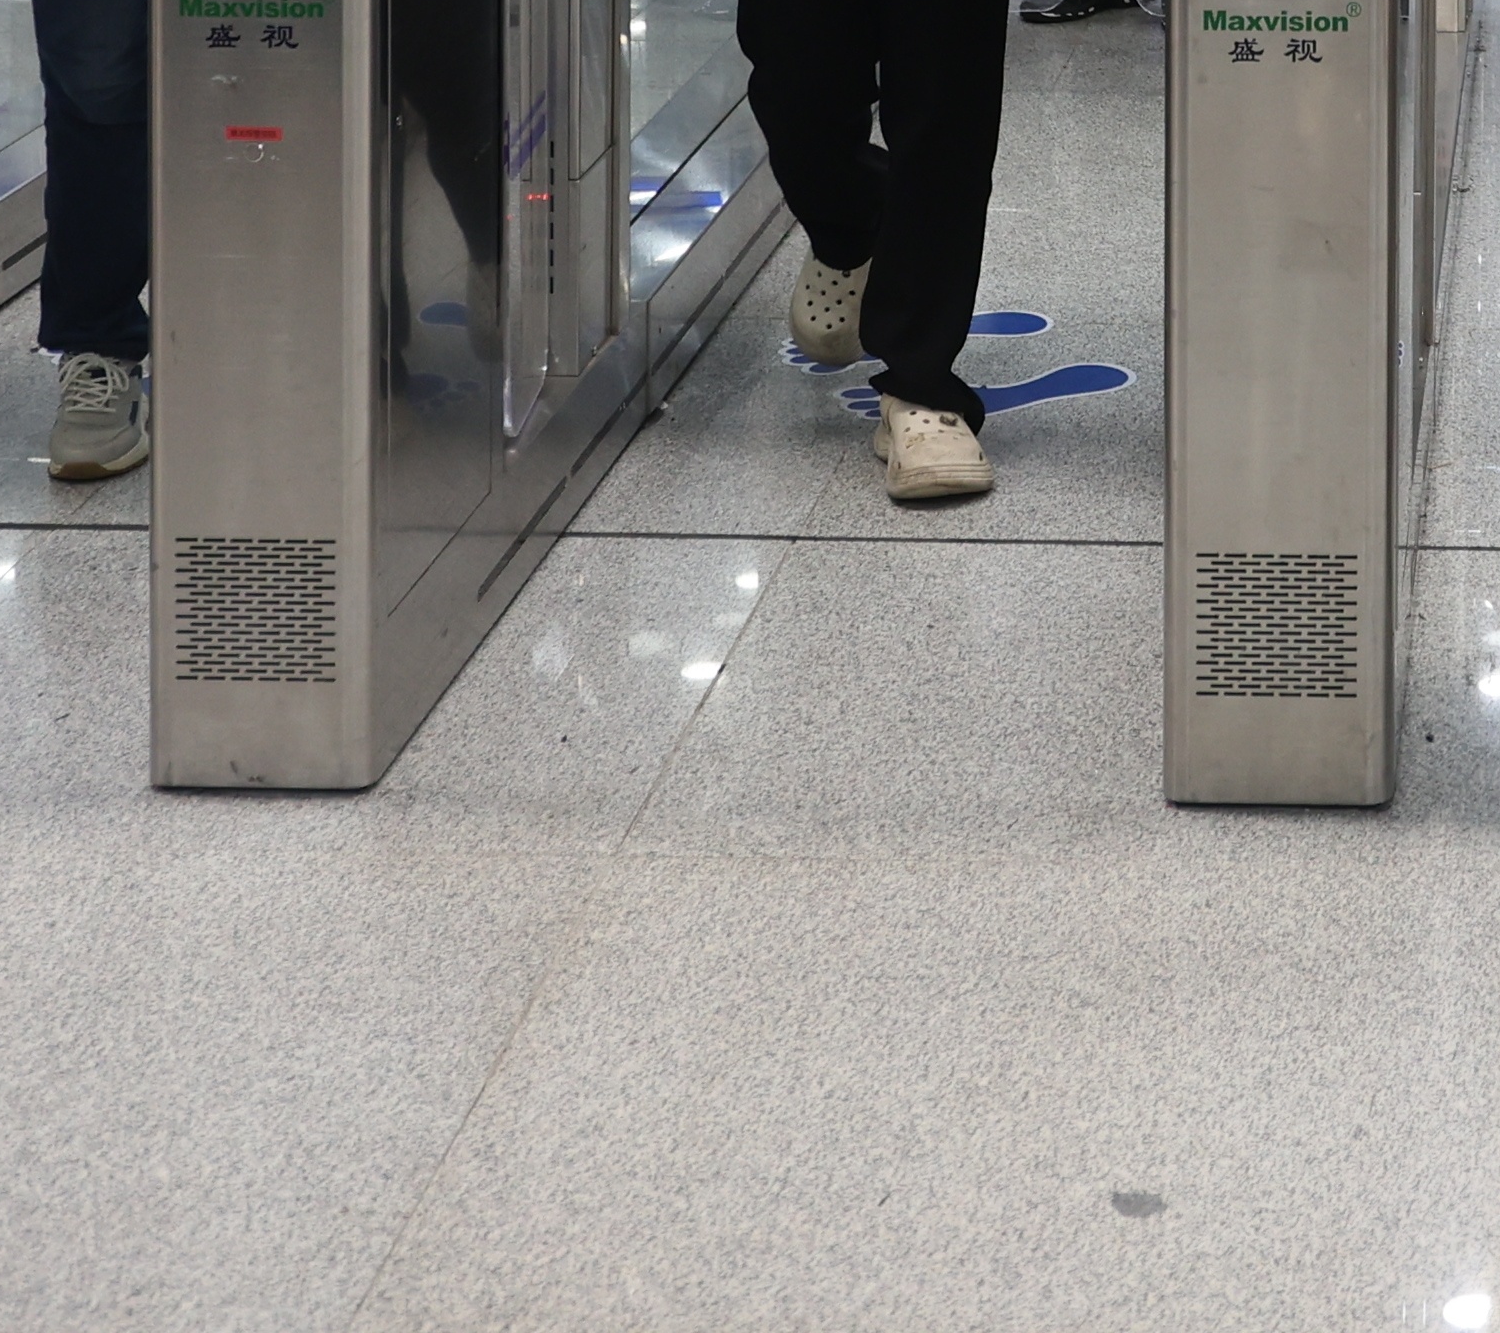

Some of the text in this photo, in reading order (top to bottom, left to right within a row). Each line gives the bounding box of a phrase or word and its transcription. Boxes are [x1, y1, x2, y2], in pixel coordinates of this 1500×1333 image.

[1202, 10, 1349, 32] Maxvision
[205, 24, 299, 49] 盛视
[1228, 37, 1324, 64] 盛视
